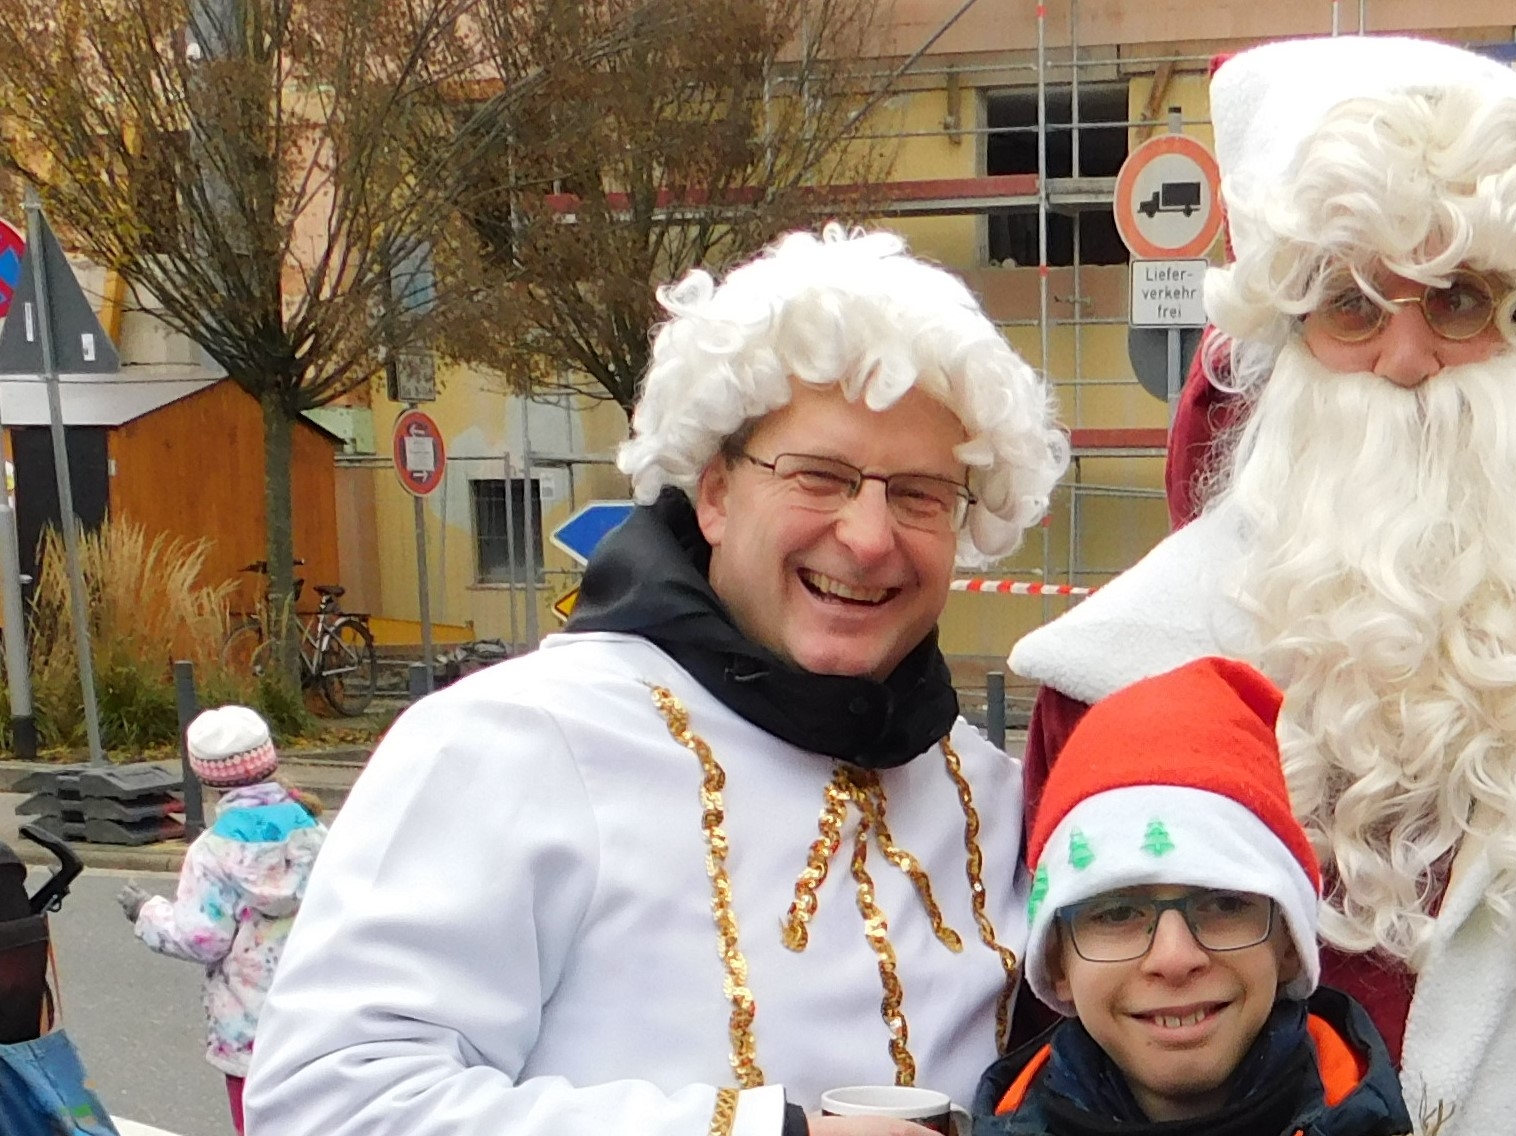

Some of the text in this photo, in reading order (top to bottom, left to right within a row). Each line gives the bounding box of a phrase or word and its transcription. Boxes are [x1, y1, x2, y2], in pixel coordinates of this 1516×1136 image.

[1145, 266, 1194, 281] Liefer-
[1141, 285, 1197, 300] verkehr
[1157, 304, 1182, 319] frei
